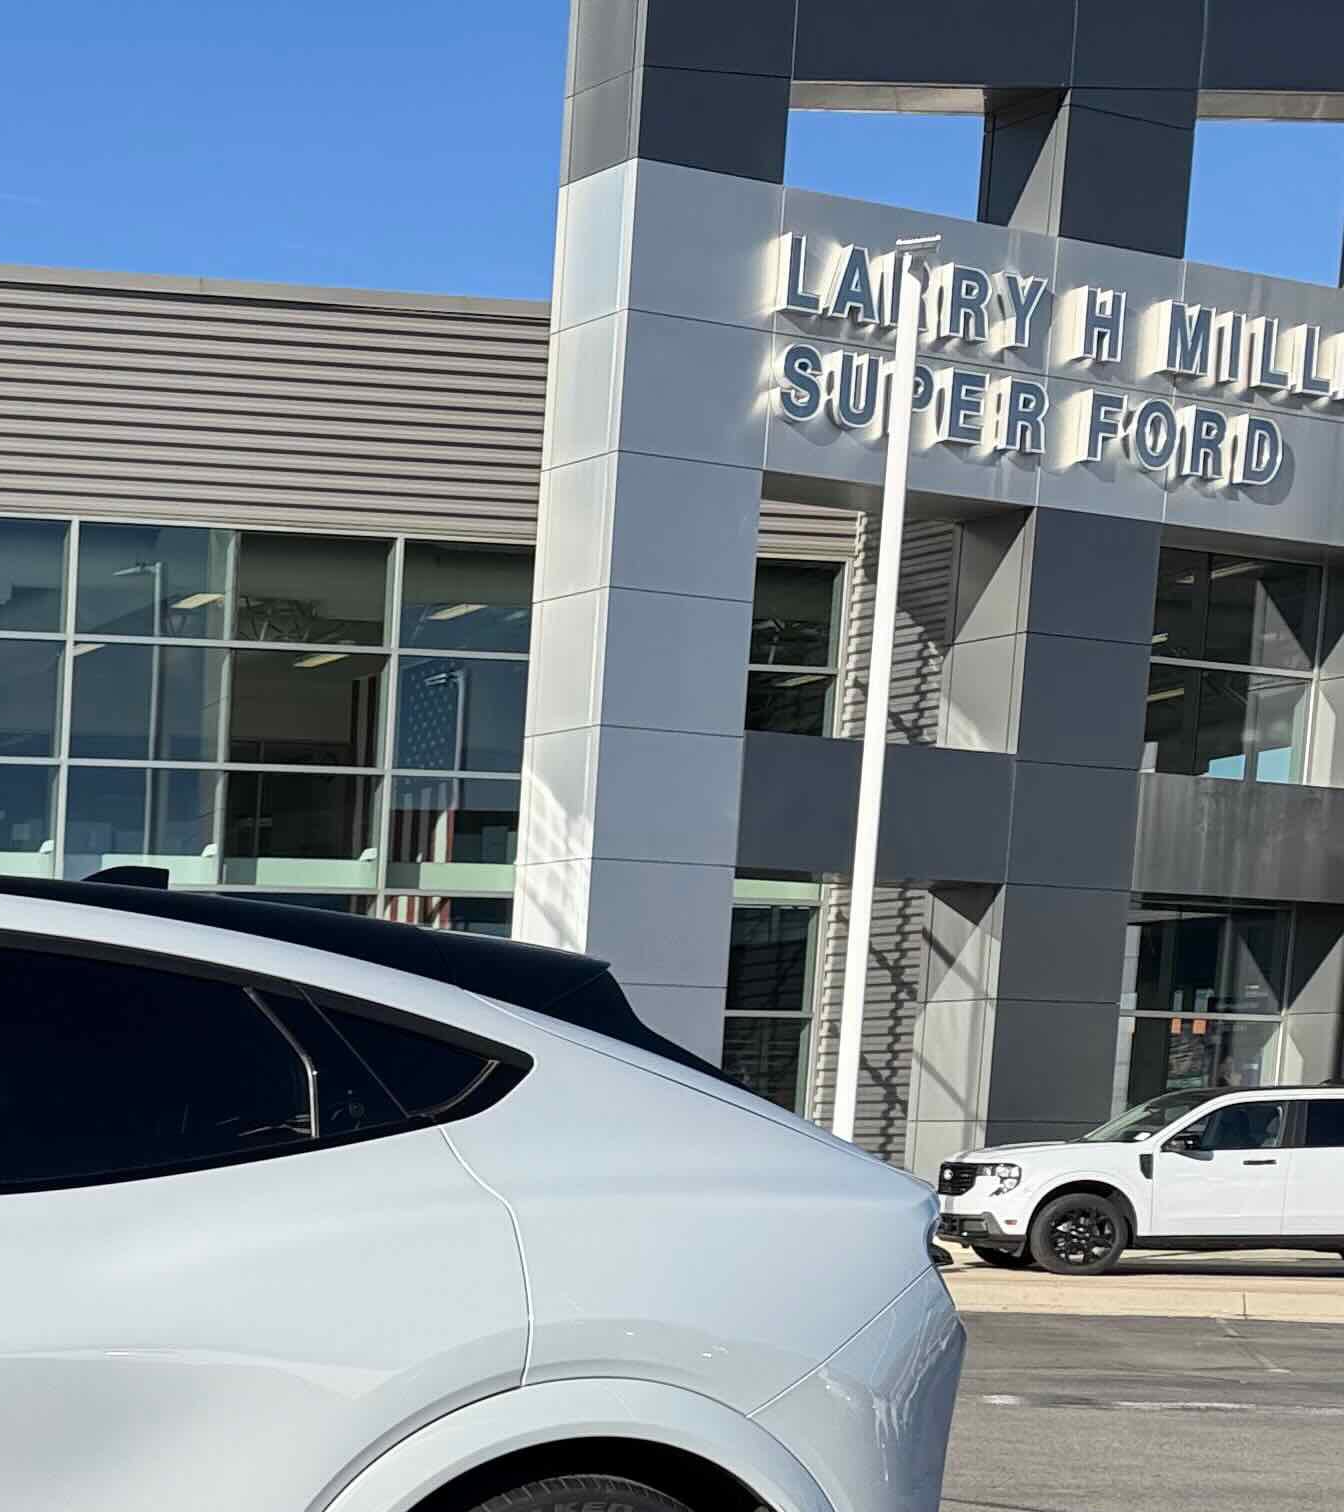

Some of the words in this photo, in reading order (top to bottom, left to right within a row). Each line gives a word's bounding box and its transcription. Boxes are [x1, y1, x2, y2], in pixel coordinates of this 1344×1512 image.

[1066, 285, 1127, 362] H
[1154, 299, 1344, 400] MILL
[1076, 388, 1284, 486] FORD
